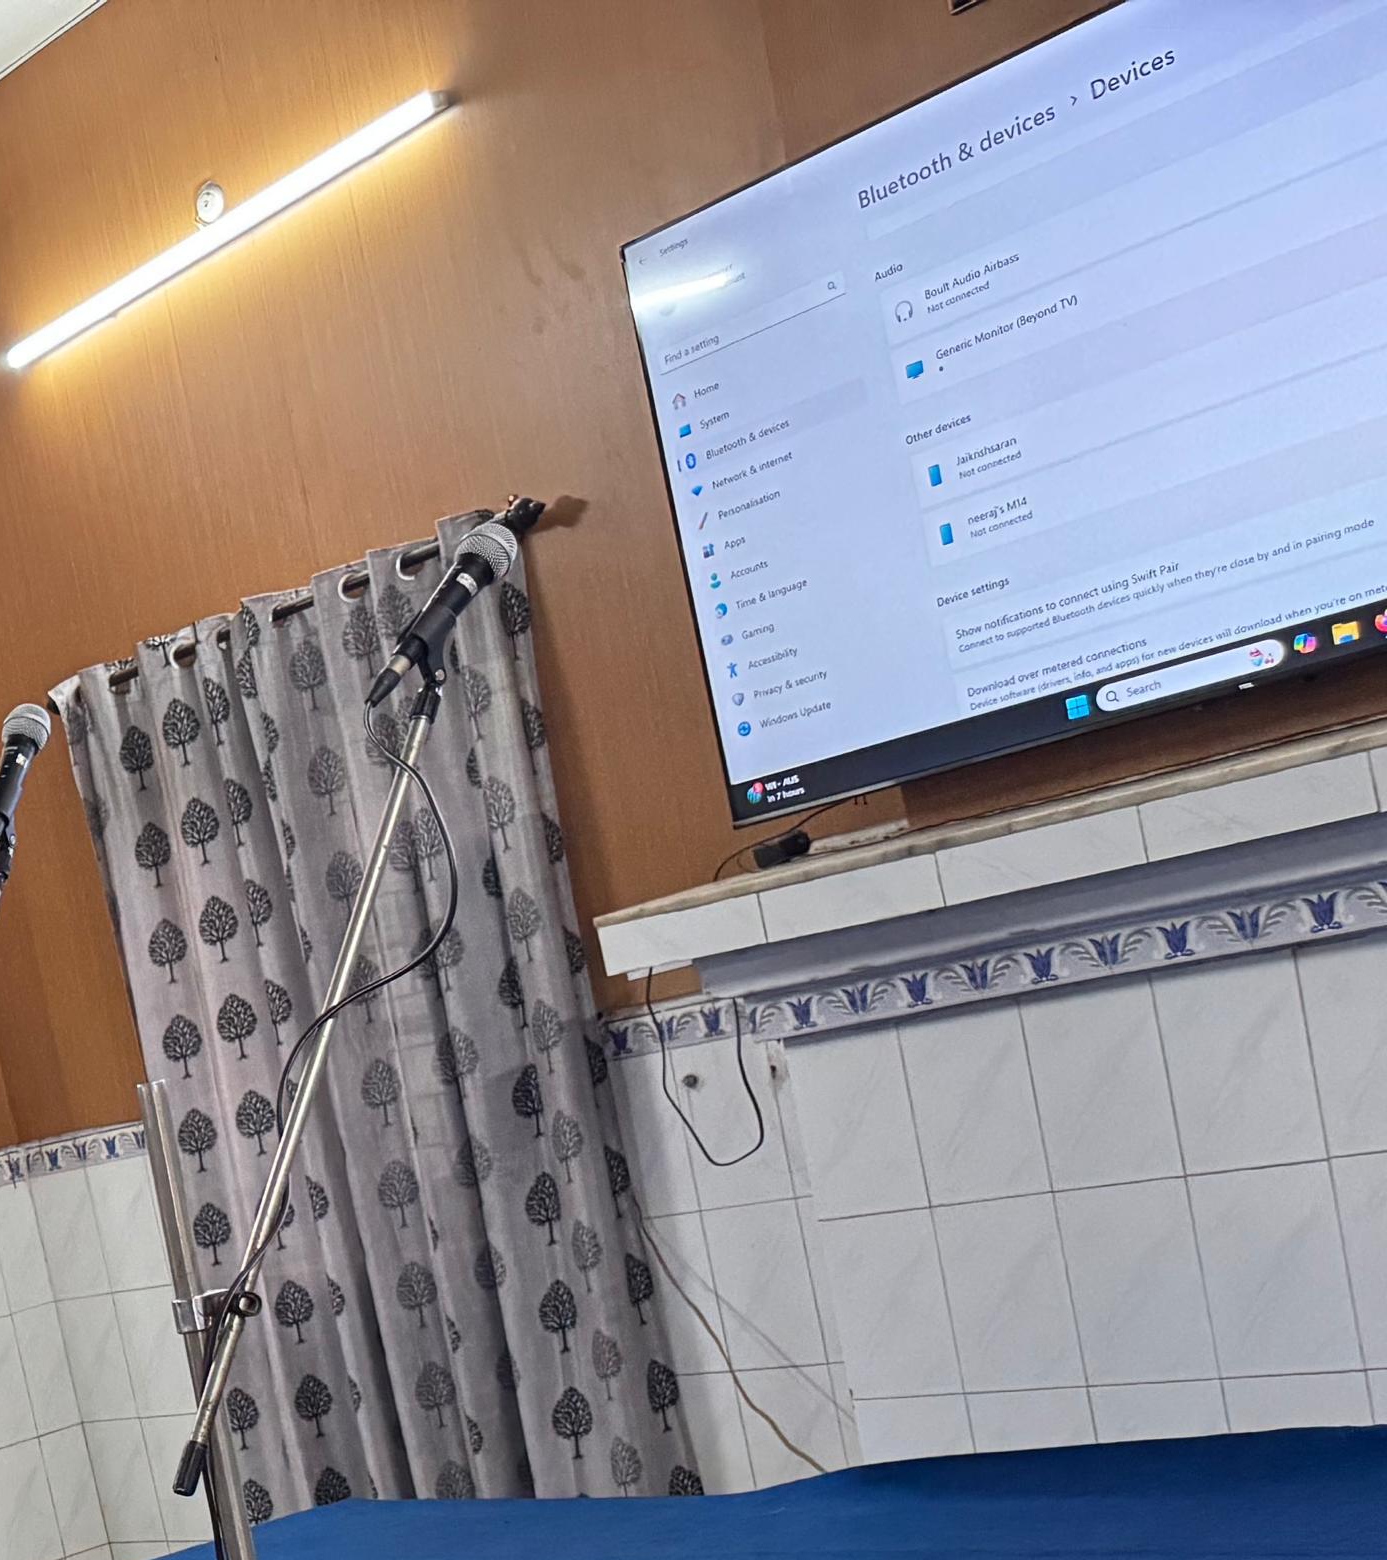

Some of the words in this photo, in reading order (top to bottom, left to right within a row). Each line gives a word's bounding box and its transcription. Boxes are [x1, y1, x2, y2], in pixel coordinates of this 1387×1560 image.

[857, 152, 951, 208] Bluetooth
[958, 142, 974, 163] &
[979, 106, 1055, 152] devices
[1090, 49, 1176, 100] Devices
[874, 263, 903, 282] Audio
[924, 282, 951, 300] Boult
[952, 270, 981, 288] Audio
[983, 253, 1020, 276] Airbass
[927, 302, 944, 314] Not
[945, 281, 990, 306] connected
[935, 338, 972, 360] Generic
[974, 322, 1014, 344] Monitor
[1016, 303, 1058, 329] (Beyond
[1059, 294, 1078, 310] TV)
[664, 350, 682, 365] Find
[684, 348, 690, 356] a
[690, 334, 720, 354] setting
[694, 382, 719, 399] Home
[699, 411, 730, 430] System
[905, 428, 933, 445] Other
[934, 413, 972, 434] devices
[705, 437, 747, 460] Bluetooth
[748, 432, 756, 442] &
[758, 419, 790, 439] devices
[711, 470, 748, 490] Network
[749, 465, 758, 475] &
[759, 451, 793, 471] internet
[959, 468, 975, 480] Not
[976, 450, 1022, 473] connected
[717, 490, 781, 520] Personalisation
[967, 505, 1005, 525] neeraj's
[1006, 496, 1028, 511] M14
[970, 527, 987, 539] Not
[988, 510, 1034, 533] connected
[724, 536, 746, 550] Apps
[730, 560, 769, 580] Accounts
[736, 598, 757, 610] Time
[758, 592, 766, 602] &
[767, 579, 808, 599] language
[936, 591, 969, 608] Device
[970, 576, 1010, 596] settings
[955, 624, 983, 640] Show
[983, 606, 1045, 632] notifications
[1045, 601, 1057, 612] to
[1058, 587, 1099, 608] connect
[1101, 577, 1130, 595] using
[1130, 568, 1158, 585] Swift
[1159, 560, 1180, 576] Pair
[958, 636, 994, 653] Connect
[994, 632, 1005, 642] to
[1006, 618, 1051, 640] supported
[1051, 604, 1096, 626] Bluetooth
[1097, 594, 1131, 611] devices
[1132, 582, 1165, 602] quickly
[1167, 575, 1193, 591] when
[1194, 563, 1228, 581] they're
[1229, 556, 1255, 570] close
[1257, 550, 1270, 562] by
[1271, 544, 1291, 557] and
[1292, 541, 1303, 551] in
[1305, 528, 1342, 548] pairing
[1344, 518, 1375, 535] mode
[741, 623, 775, 640] Gaming
[748, 647, 798, 670] Accessibility
[970, 696, 999, 711] Device
[999, 685, 1037, 703] software
[1037, 675, 1074, 693] (drivers,
[1073, 668, 1094, 684] info,
[1095, 663, 1114, 676] and
[1114, 656, 1141, 673] apps)
[1140, 652, 1156, 663] for
[1155, 646, 1178, 658] new
[1178, 634, 1215, 653] devices
[1214, 628, 1233, 642] will
[1233, 613, 1283, 636] download
[1284, 606, 1313, 623] when
[1313, 596, 1347, 615] you're
[1348, 592, 1363, 602] on
[966, 675, 1016, 698] Download
[1017, 668, 1040, 682] over
[1041, 655, 1084, 676] metered
[1085, 637, 1148, 665] connections
[753, 683, 783, 699] Privacy
[785, 679, 793, 689] &
[794, 670, 828, 687] security
[1126, 680, 1162, 698] Search
[759, 710, 798, 729] Windows
[799, 701, 832, 717] Update
[782, 786, 806, 799] hours
